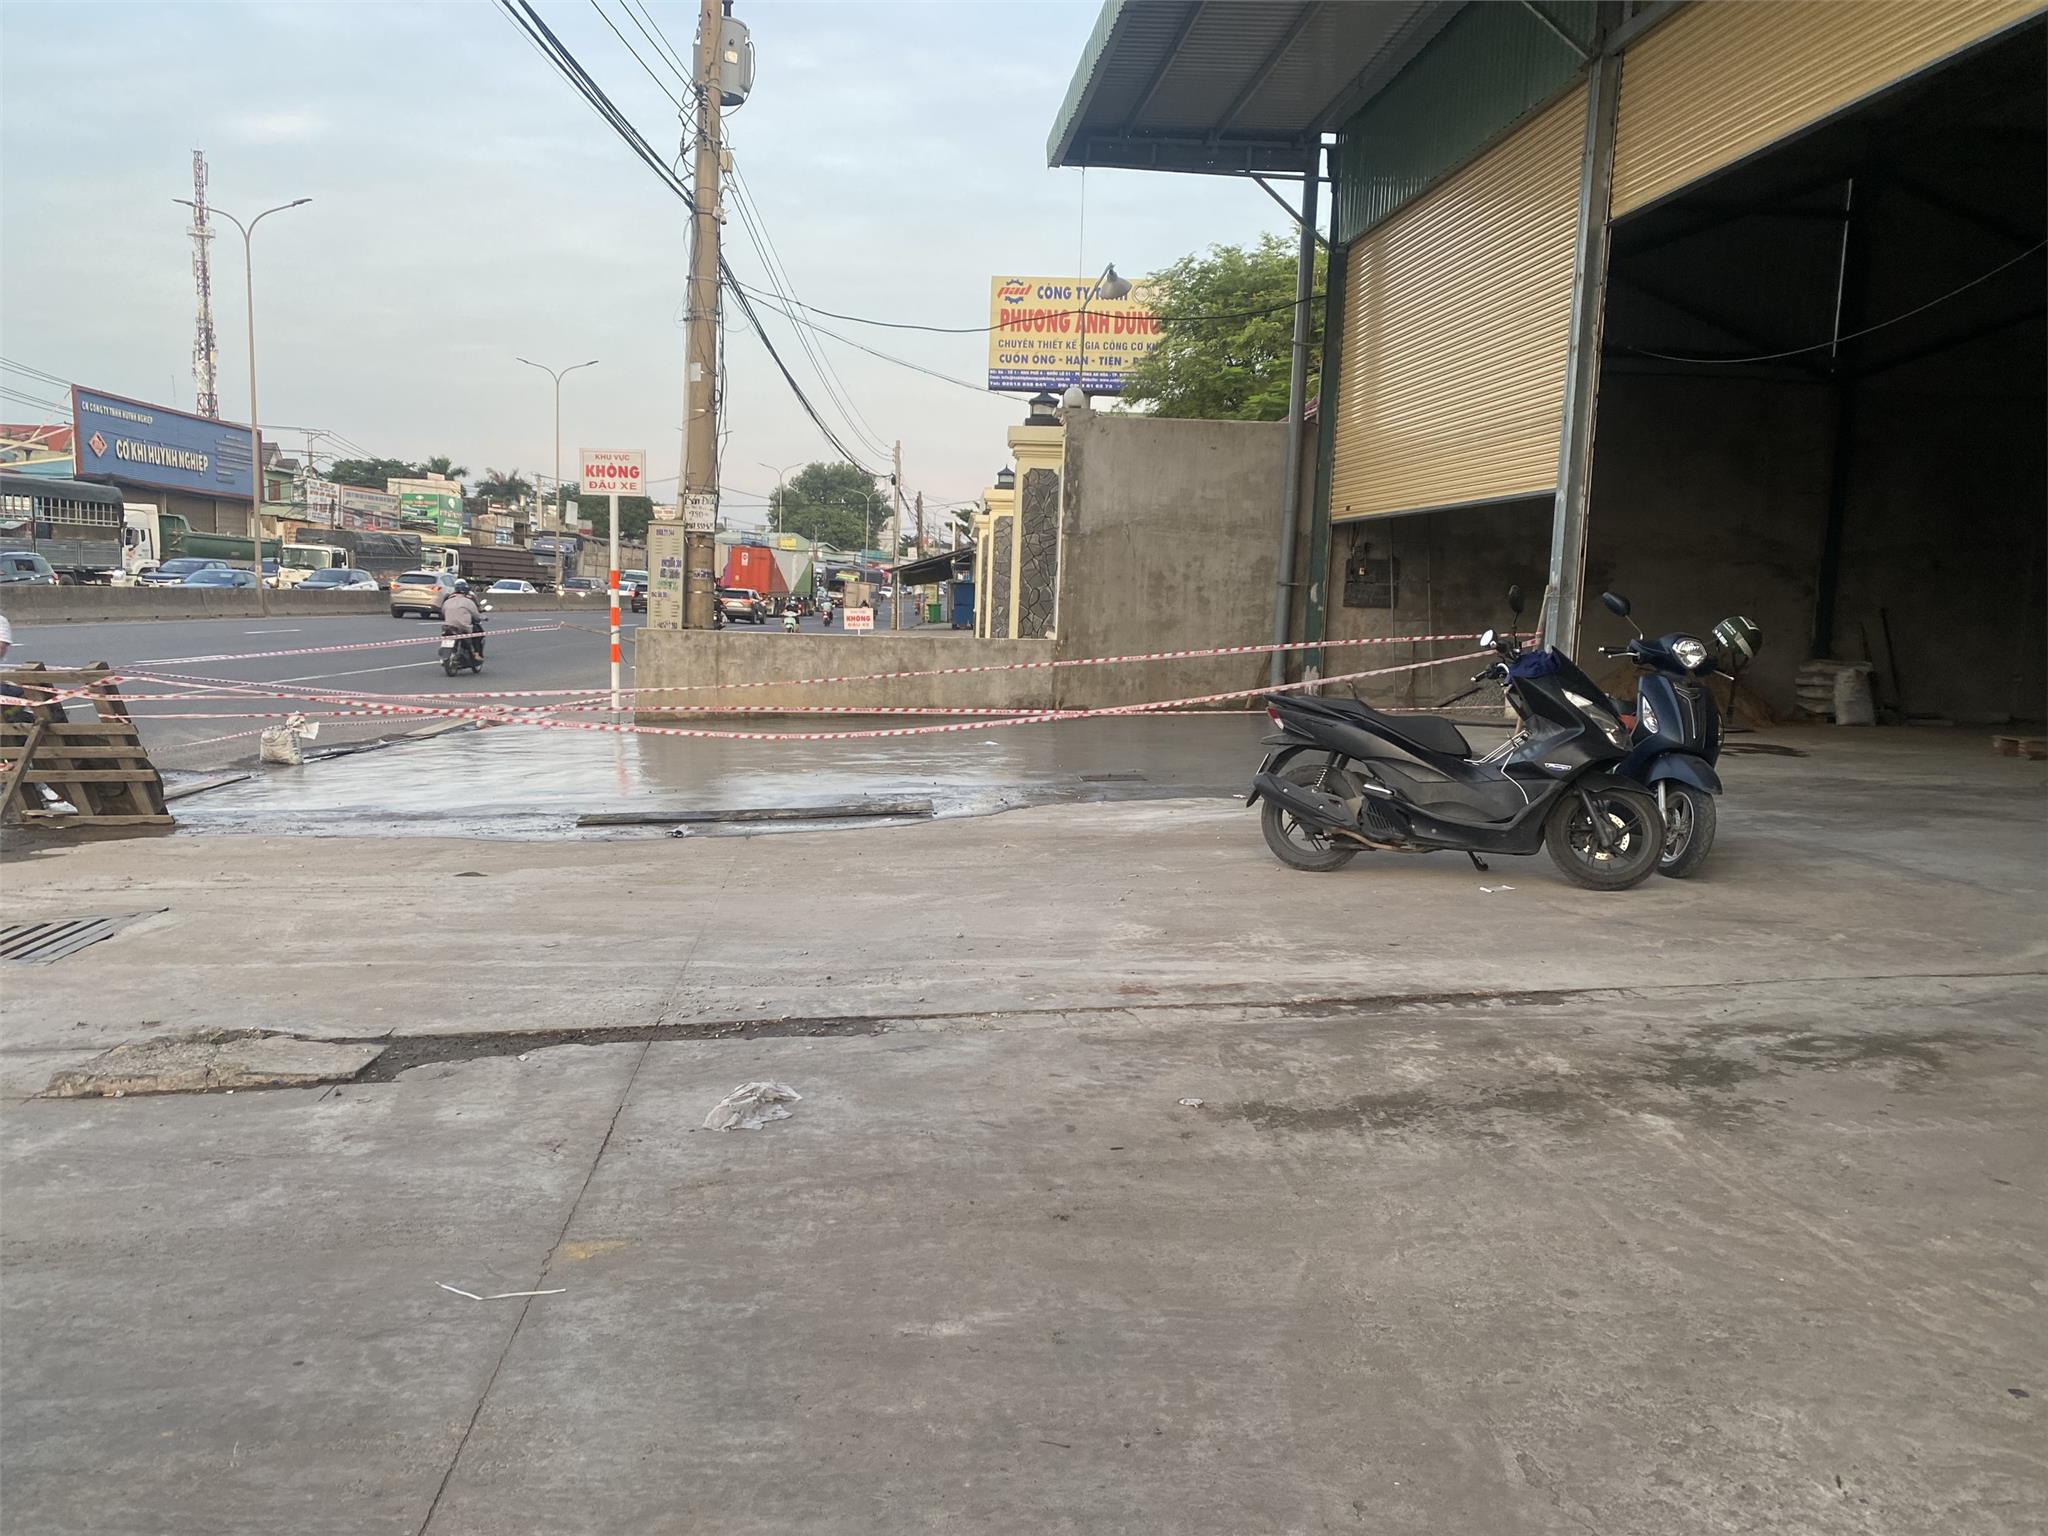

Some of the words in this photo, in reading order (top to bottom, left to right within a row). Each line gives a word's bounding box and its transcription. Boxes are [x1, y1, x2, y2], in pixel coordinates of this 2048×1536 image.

[1037, 283, 1072, 299] CÔNG
[1075, 286, 1089, 300] TY
[1000, 308, 1071, 333] PHƯƠNG
[1075, 310, 1109, 334] ANH
[998, 337, 1034, 349] CHUYÊN
[1037, 337, 1063, 350] THIẾT
[1085, 341, 1100, 350] GIA
[1102, 340, 1128, 351] CÔNG
[148, 442, 178, 468] HUỲNH
[178, 450, 209, 477] NGHIỆP
[594, 453, 612, 461] KHU
[613, 453, 631, 462] VỰC
[585, 462, 640, 479] KHÔNG
[620, 481, 637, 490] XE
[846, 614, 871, 622] KHÔNG
